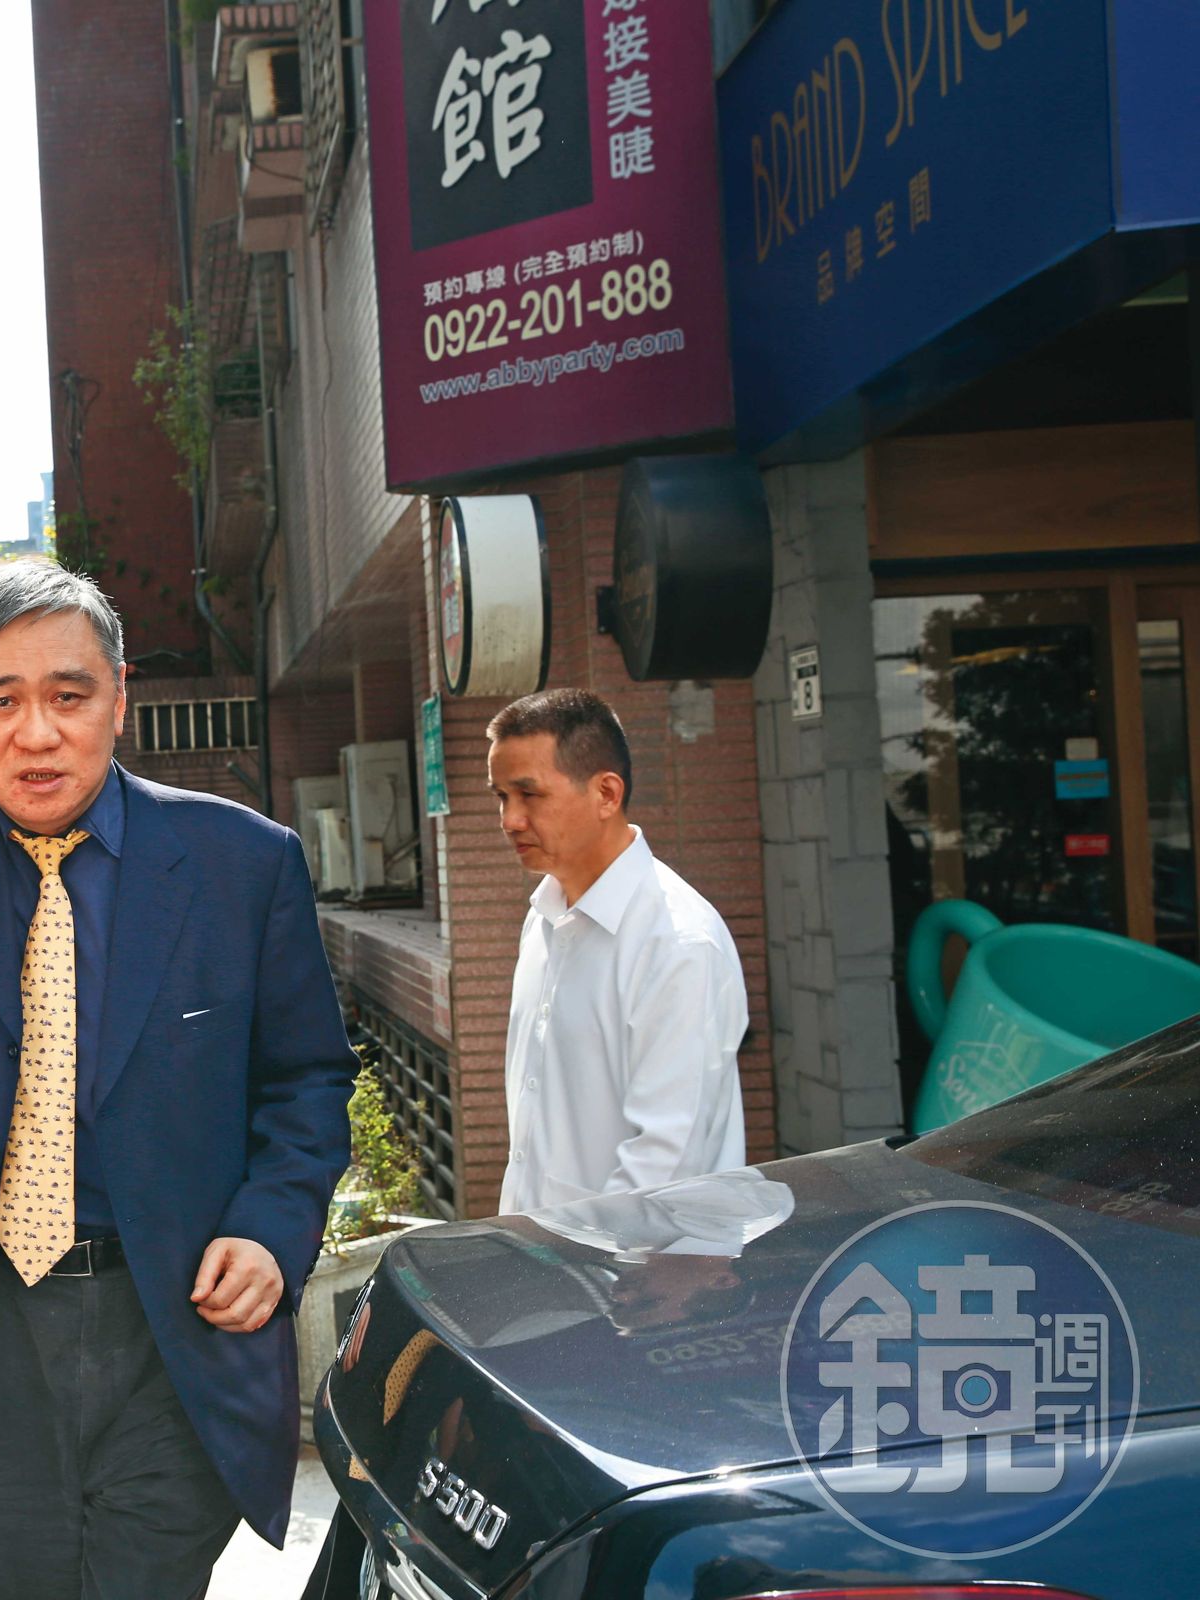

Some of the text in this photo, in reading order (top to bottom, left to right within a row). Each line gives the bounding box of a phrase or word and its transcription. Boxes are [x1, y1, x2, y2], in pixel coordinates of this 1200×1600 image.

[431, 0, 552, 188] 館
[602, 0, 656, 180] 接美睫
[751, 36, 866, 264] BRAND
[423, 229, 645, 306] 預約專線 (完全預約制)
[424, 258, 673, 362] 0922-201-888
[419, 327, 685, 404] www.abbyparty.com
[417, 1456, 510, 1551] S500
